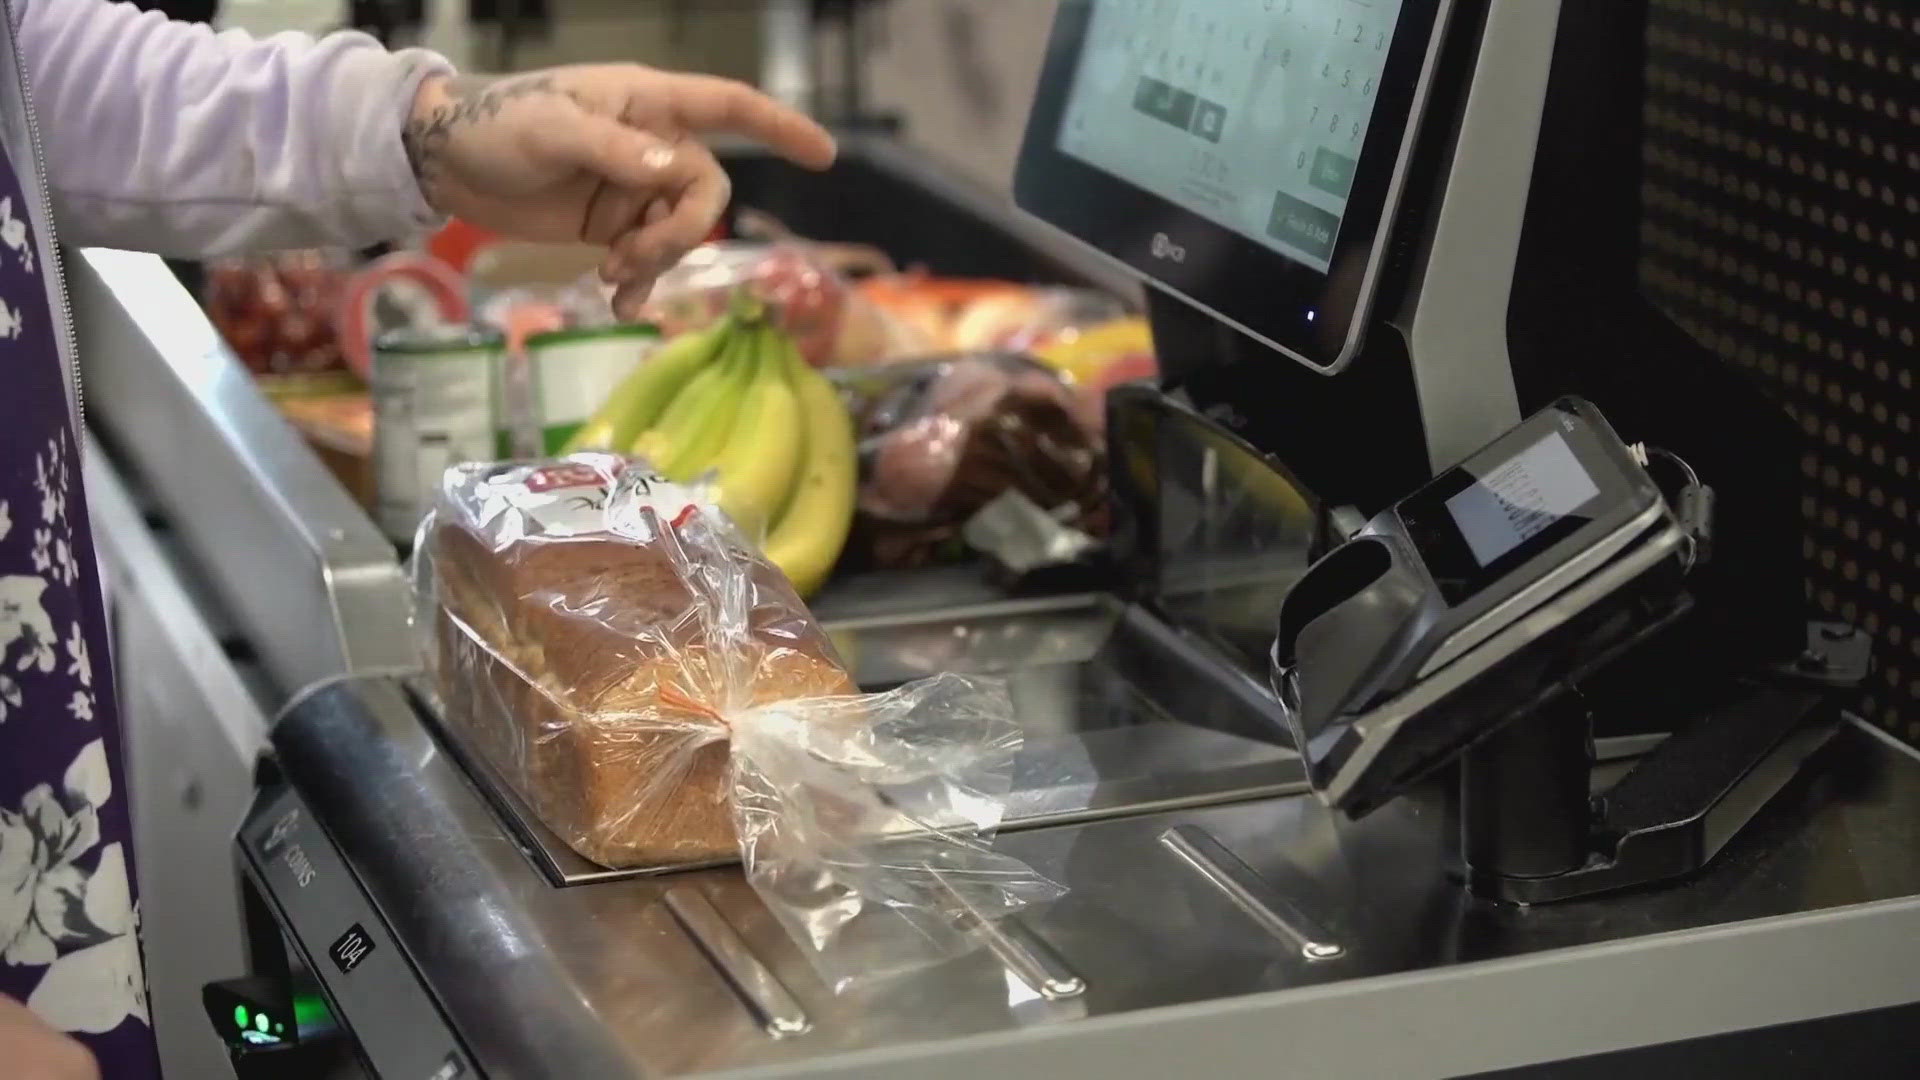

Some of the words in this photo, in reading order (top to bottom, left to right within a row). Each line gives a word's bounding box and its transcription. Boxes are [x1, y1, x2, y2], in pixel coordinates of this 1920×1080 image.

[1335, 17, 1342, 35] 1
[1353, 24, 1363, 43] 2
[1375, 33, 1384, 51] 3
[1322, 63, 1329, 77] 4
[1341, 69, 1351, 88] 5
[1363, 77, 1371, 96] 6
[1310, 106, 1319, 123] 7
[1329, 114, 1339, 133] 8
[1350, 122, 1359, 141] 9
[1298, 151, 1305, 168] 0
[283, 844, 316, 887] COINS
[337, 932, 367, 969] 104
